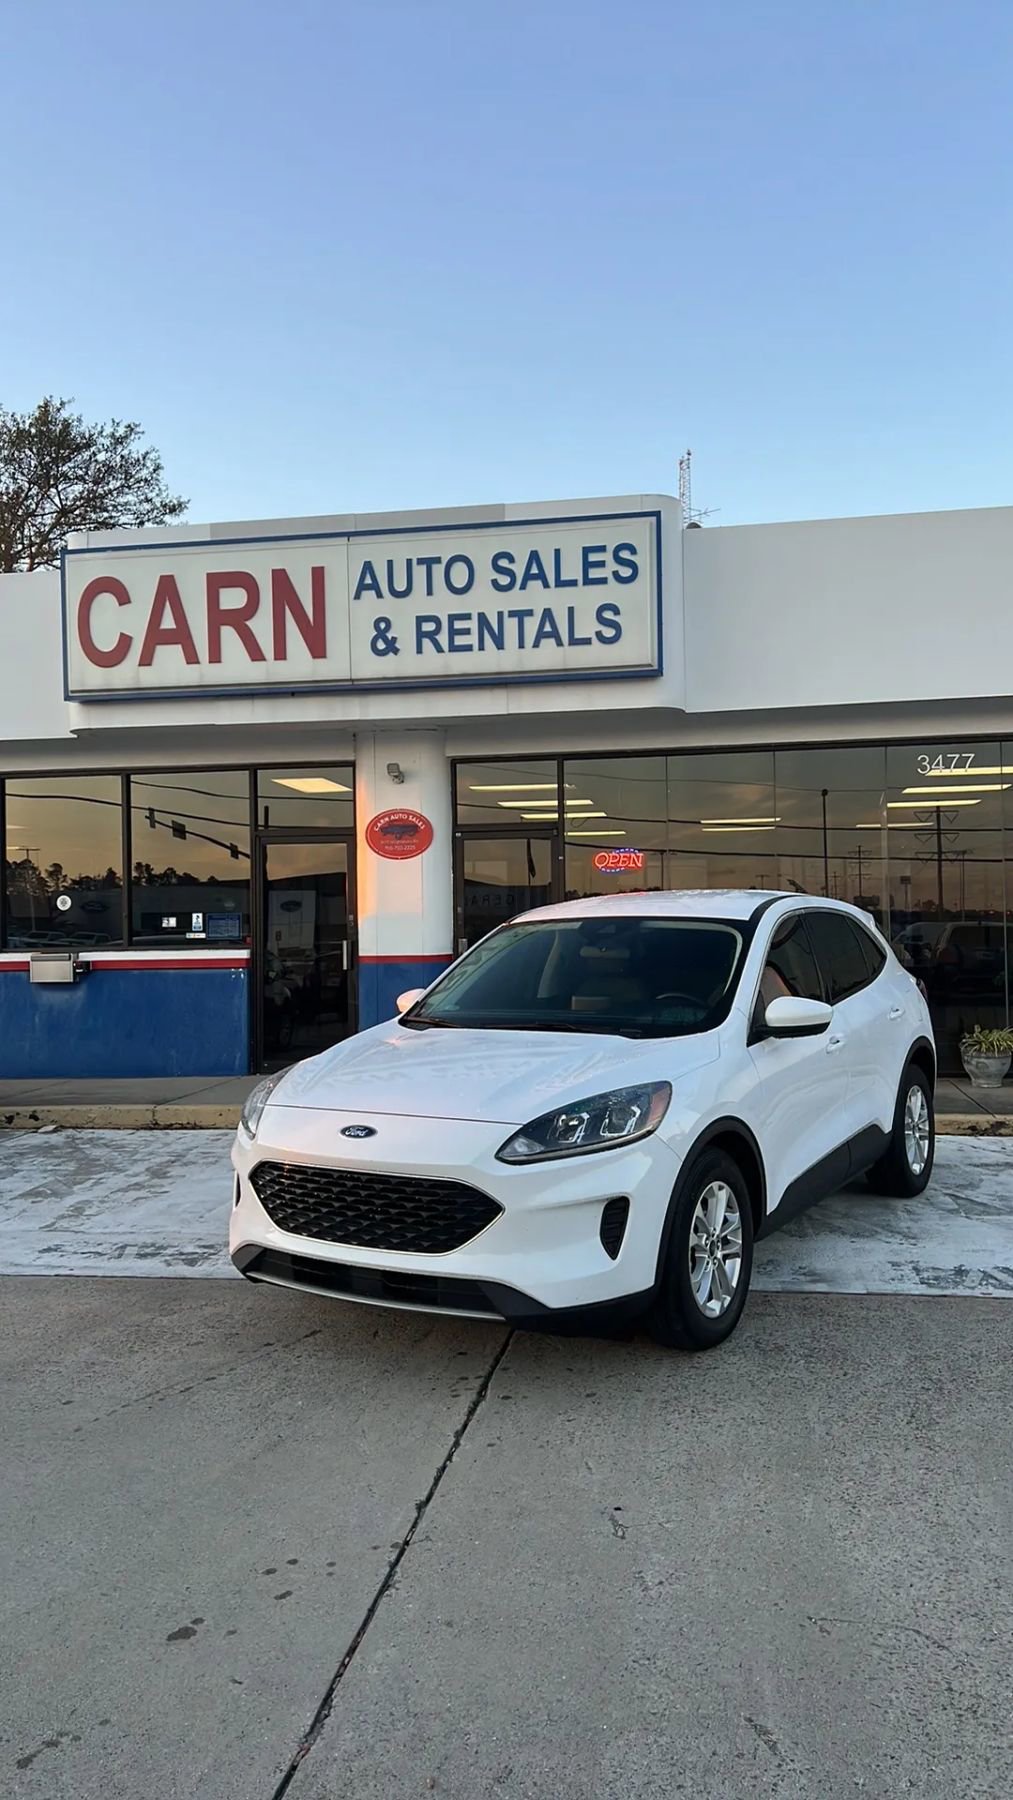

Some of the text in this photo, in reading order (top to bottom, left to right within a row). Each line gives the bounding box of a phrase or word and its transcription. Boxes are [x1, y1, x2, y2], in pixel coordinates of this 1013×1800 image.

[353, 541, 640, 601] AUTO SALES
[77, 565, 327, 669] CARN
[369, 602, 623, 658] & RENTALS
[917, 753, 975, 775] 3477
[390, 813, 408, 821] AUTO
[408, 814, 426, 830] SALES
[594, 852, 644, 868] OPEN
[344, 1126, 369, 1136] Ford
